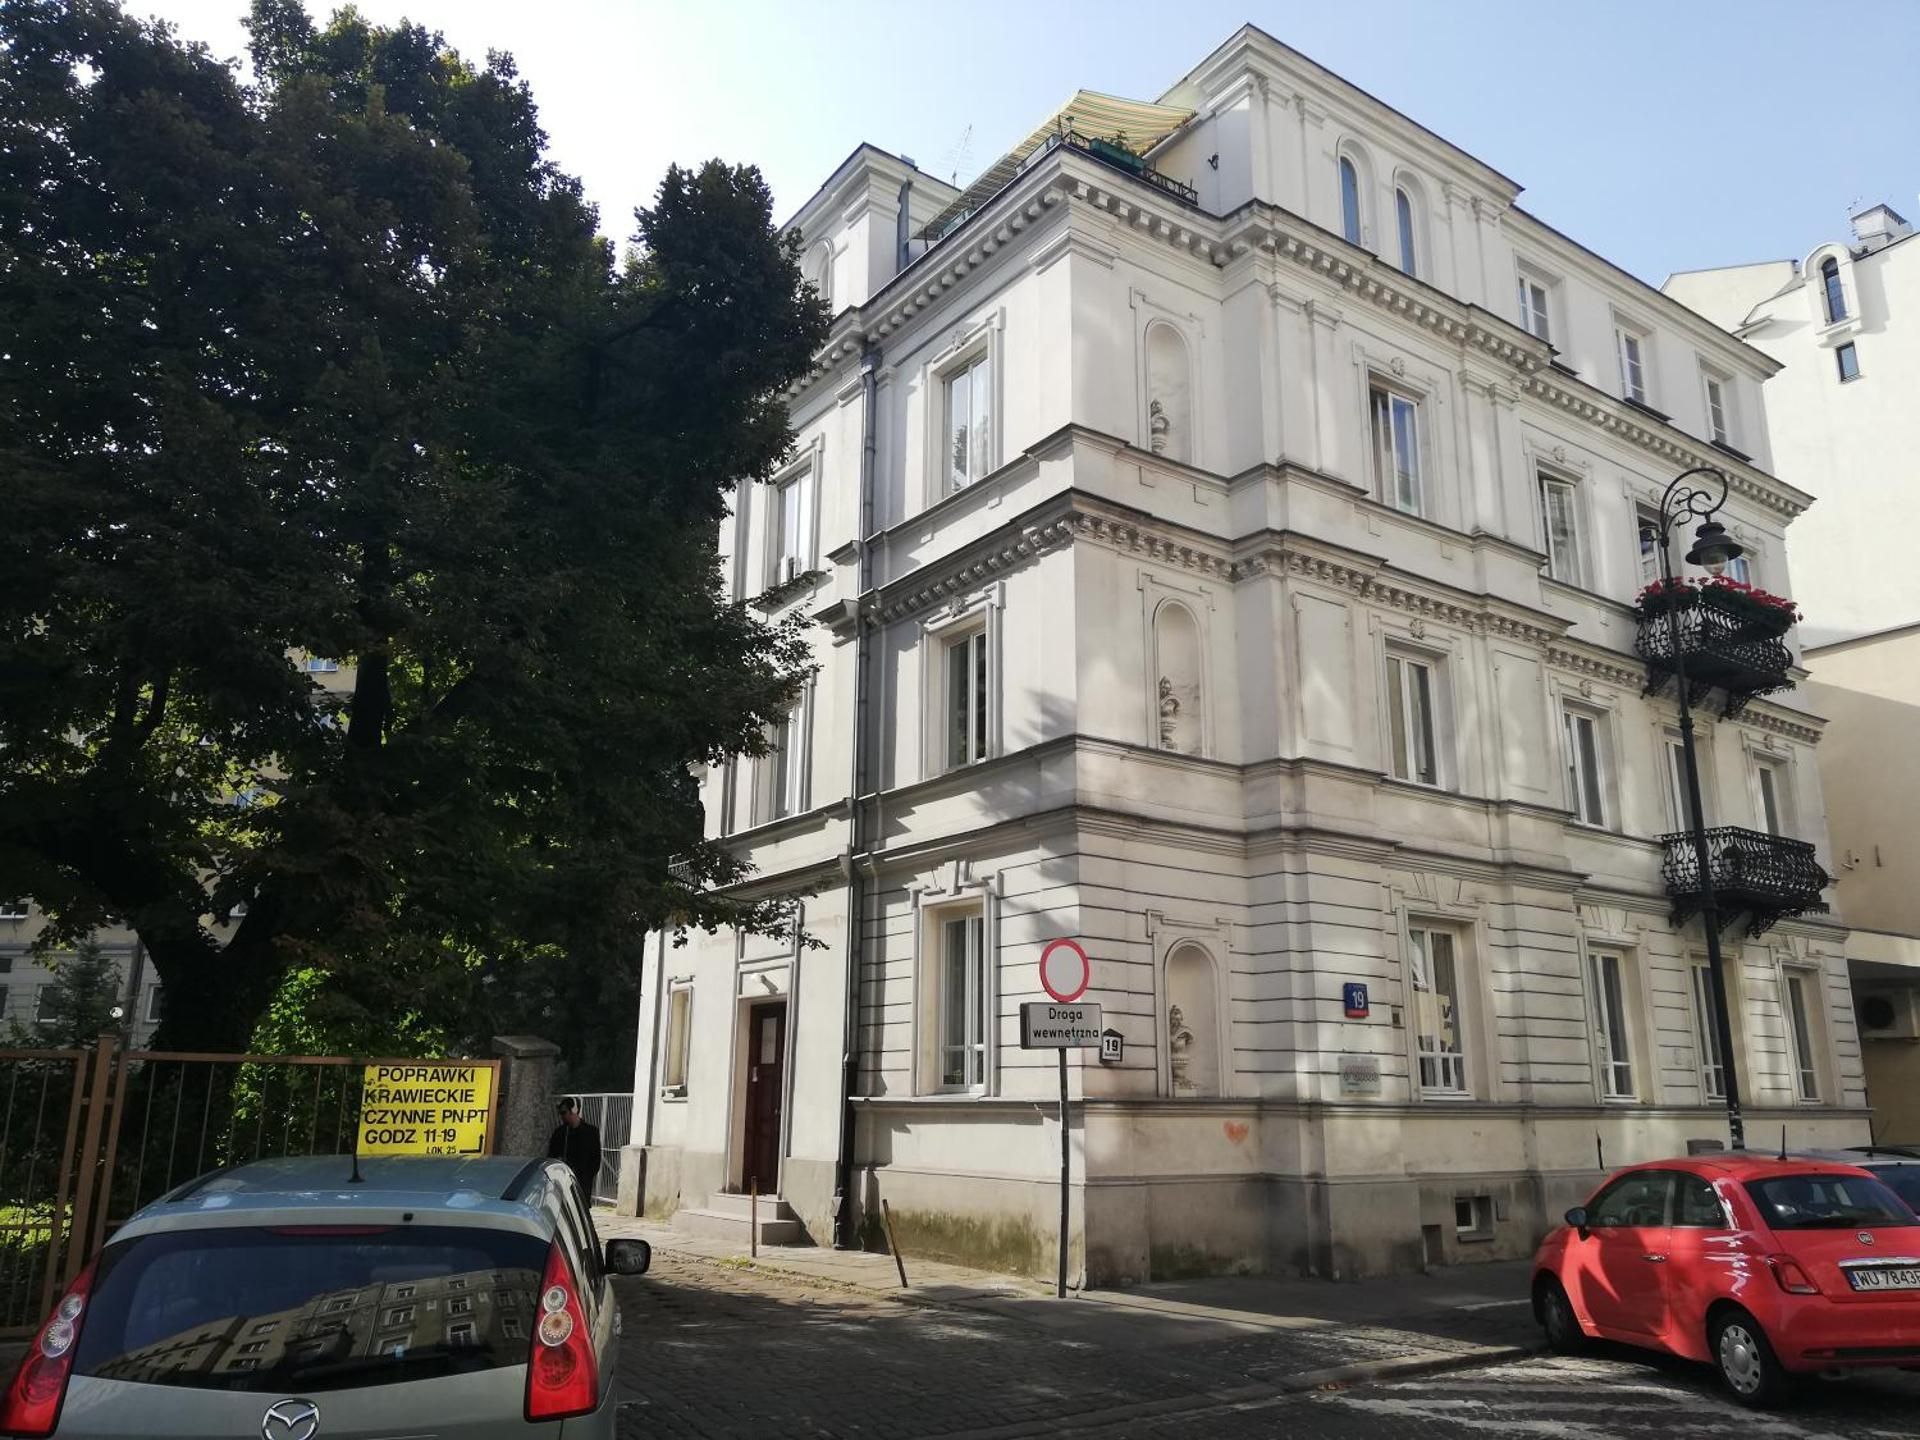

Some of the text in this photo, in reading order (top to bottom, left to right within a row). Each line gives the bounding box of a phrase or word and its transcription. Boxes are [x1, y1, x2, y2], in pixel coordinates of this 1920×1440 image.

[1352, 991, 1364, 1009] 19
[1048, 1007, 1083, 1023] Droga
[1033, 1027, 1099, 1041] wewnętrzna
[1105, 1039, 1118, 1051] 19
[377, 1067, 475, 1083] POPRAWKI
[364, 1088, 475, 1104] KRAWIECKIE
[364, 1109, 436, 1124] CZYNNE
[365, 1128, 456, 1145] GODZ. 11-19
[426, 1146, 456, 1154] LOK 25
[1856, 1271, 1880, 1286] WU
